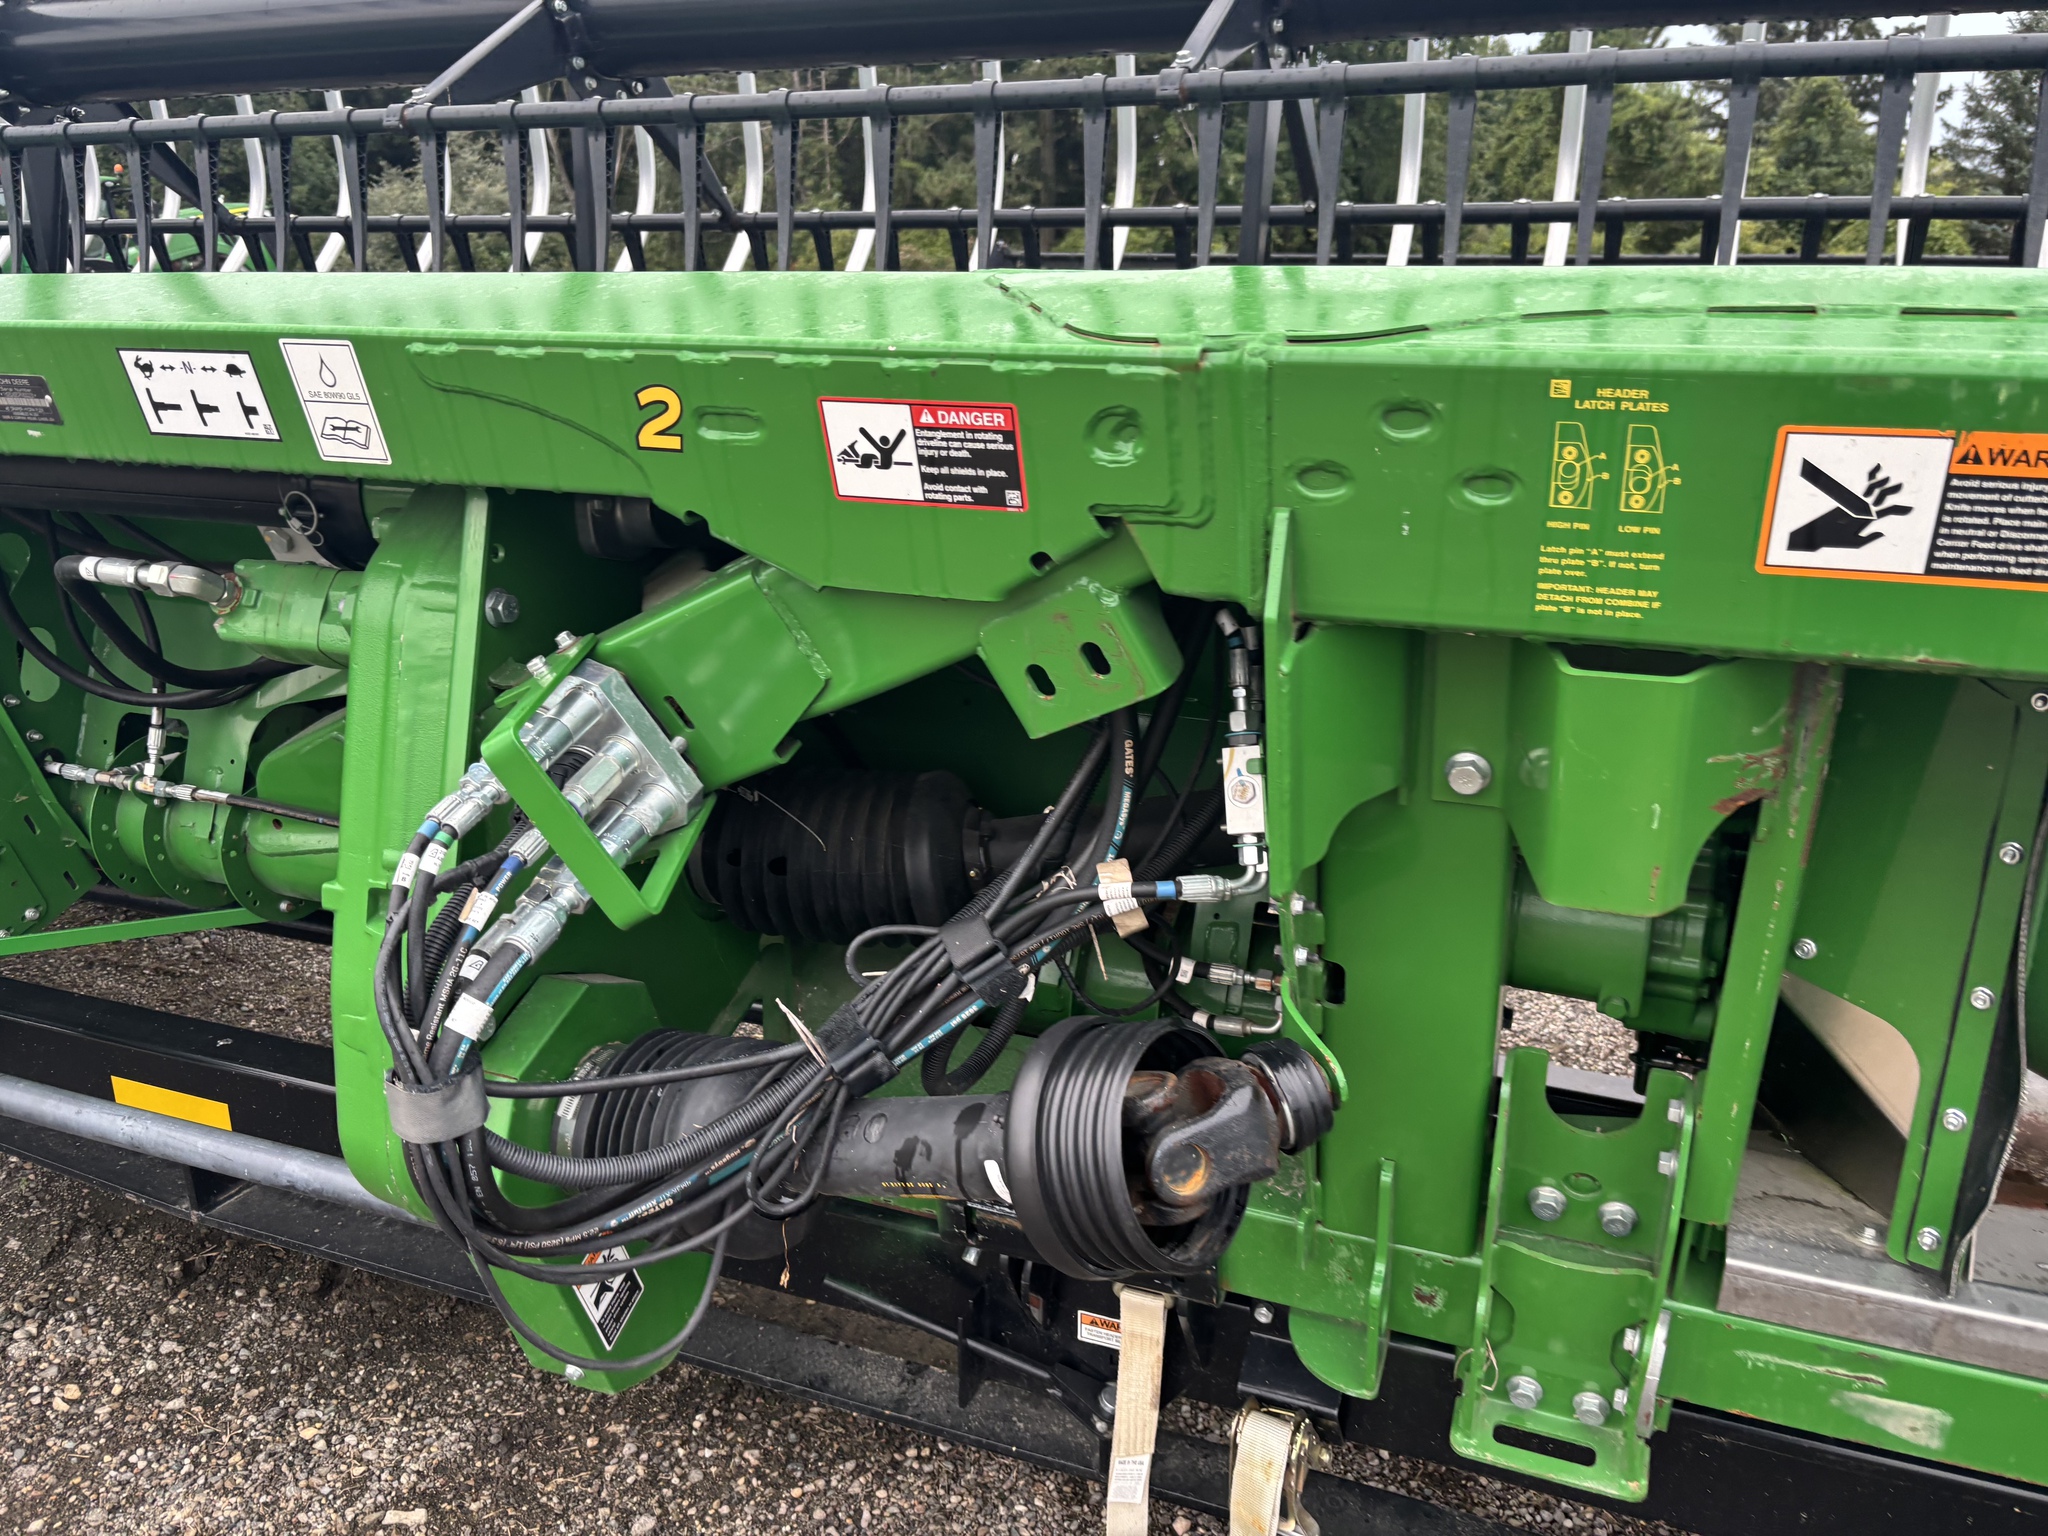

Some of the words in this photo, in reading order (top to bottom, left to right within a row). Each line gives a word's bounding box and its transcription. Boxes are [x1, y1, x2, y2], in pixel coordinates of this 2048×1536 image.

[308, 390, 322, 399] SAE
[323, 391, 345, 400] 80W90
[347, 392, 360, 400] GL5
[1596, 388, 1649, 399] HEADER
[1575, 400, 1615, 410] LATCH
[1620, 401, 1669, 412] PLATES
[634, 384, 683, 453] 2
[937, 410, 1005, 426] DANGER
[915, 428, 964, 439] Entanglement
[966, 431, 973, 439] in
[974, 432, 1003, 442] rotating
[917, 439, 947, 447] driveline
[986, 442, 1014, 450] serious
[918, 447, 938, 457] injury
[949, 449, 972, 457] death.
[921, 465, 939, 475] Keep
[941, 466, 949, 474] all
[950, 467, 976, 475] shields
[977, 468, 985, 476] in
[986, 469, 1008, 478] place.
[924, 483, 944, 491] Avoid
[945, 485, 971, 493] contact
[972, 486, 988, 494] with
[1950, 478, 1980, 487] Avoid
[1981, 481, 2019, 490] serious
[925, 493, 952, 502] rotating
[953, 494, 974, 502] parts.
[1947, 492, 2000, 501] movement
[1944, 503, 1972, 512] Knife
[1973, 505, 2006, 514] moves
[2008, 507, 2035, 515] when
[1546, 521, 1571, 529] HIGH
[1573, 522, 1590, 530] PIN
[1941, 515, 1952, 523] is
[1953, 516, 1991, 525] rotated.
[1992, 517, 2021, 527] Place
[2022, 520, 2048, 528] main
[1618, 525, 1641, 533] LOW
[1643, 526, 1661, 534] PIN
[1951, 528, 1986, 537] neutral
[1936, 538, 1970, 547] Center
[1970, 540, 1996, 549] Feed
[1997, 541, 2023, 551] drive
[1540, 545, 1566, 553] Latch
[1569, 547, 1584, 555] pin
[1586, 548, 1603, 556] "A"
[1631, 551, 1665, 560] extend
[1961, 553, 2016, 564] performing
[1561, 558, 1585, 566] plate
[1639, 563, 1660, 571] turn
[1930, 562, 1993, 572] maintenance
[2009, 566, 2032, 575] feed
[1538, 567, 1562, 575] plate
[1564, 569, 1587, 577] over.
[1537, 582, 1594, 593] IMPORTANT:
[1595, 587, 1636, 596] HEADER
[1638, 589, 1659, 598] MAY
[1536, 593, 1573, 602] DETACH
[1575, 596, 1603, 605] FROM
[1605, 598, 1650, 608] COMBINE
[1651, 601, 1661, 609] IF
[1535, 604, 1557, 612] plate
[1615, 610, 1644, 619] place.
[495, 871, 513, 893] POWER
[425, 1004, 446, 1041] Resistant
[440, 976, 455, 1005] MSHA
[565, 1232, 582, 1243] MPa
